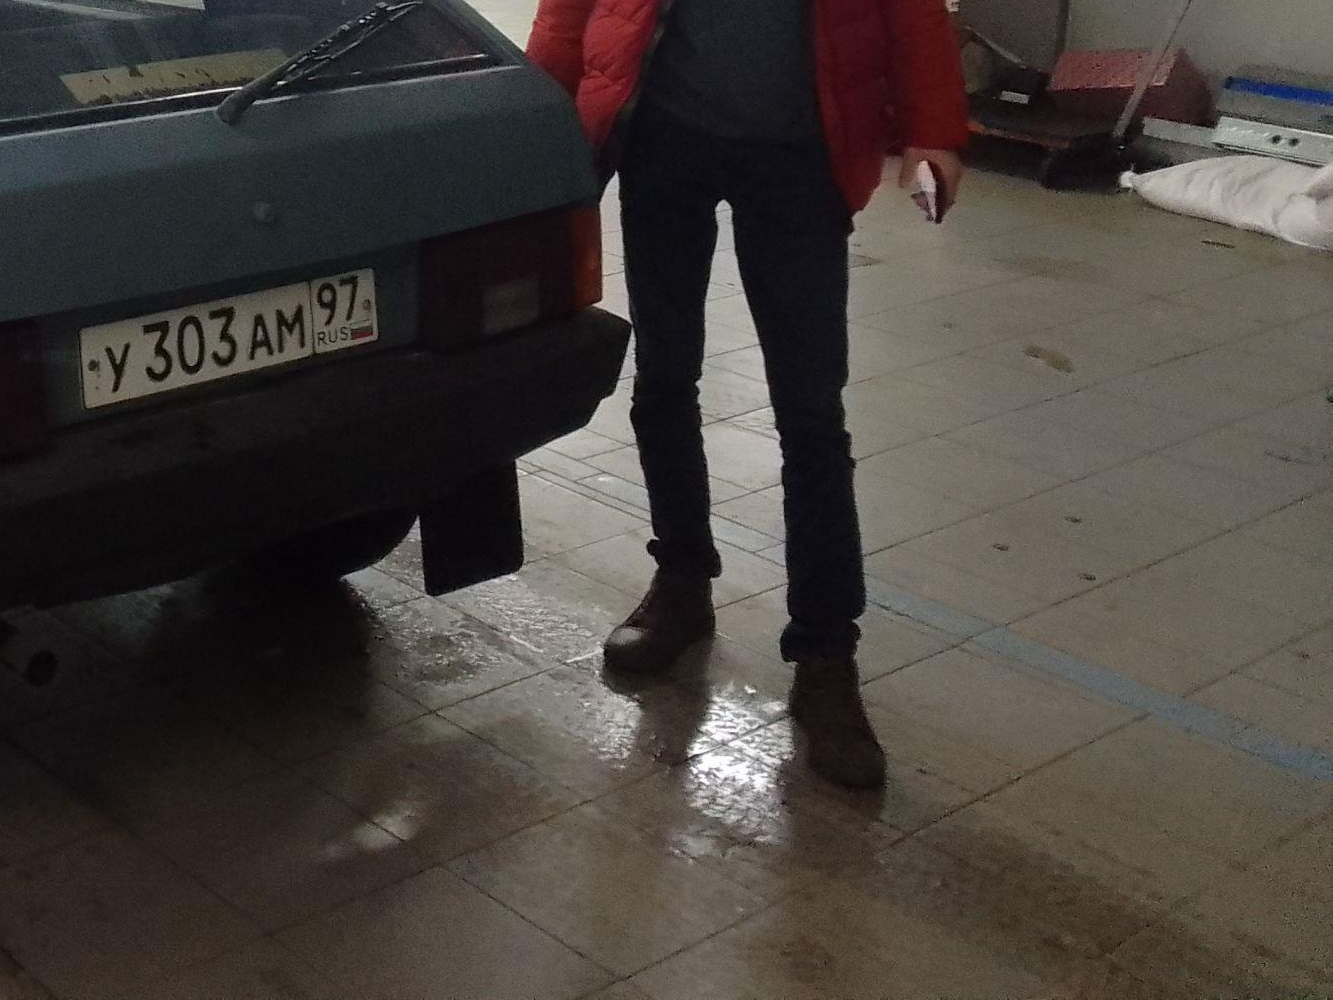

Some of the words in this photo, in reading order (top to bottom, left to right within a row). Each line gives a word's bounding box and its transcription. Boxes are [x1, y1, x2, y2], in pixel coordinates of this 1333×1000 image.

[104, 304, 307, 393] У303АМ
[317, 275, 359, 327] 97
[316, 327, 350, 347] RUS
